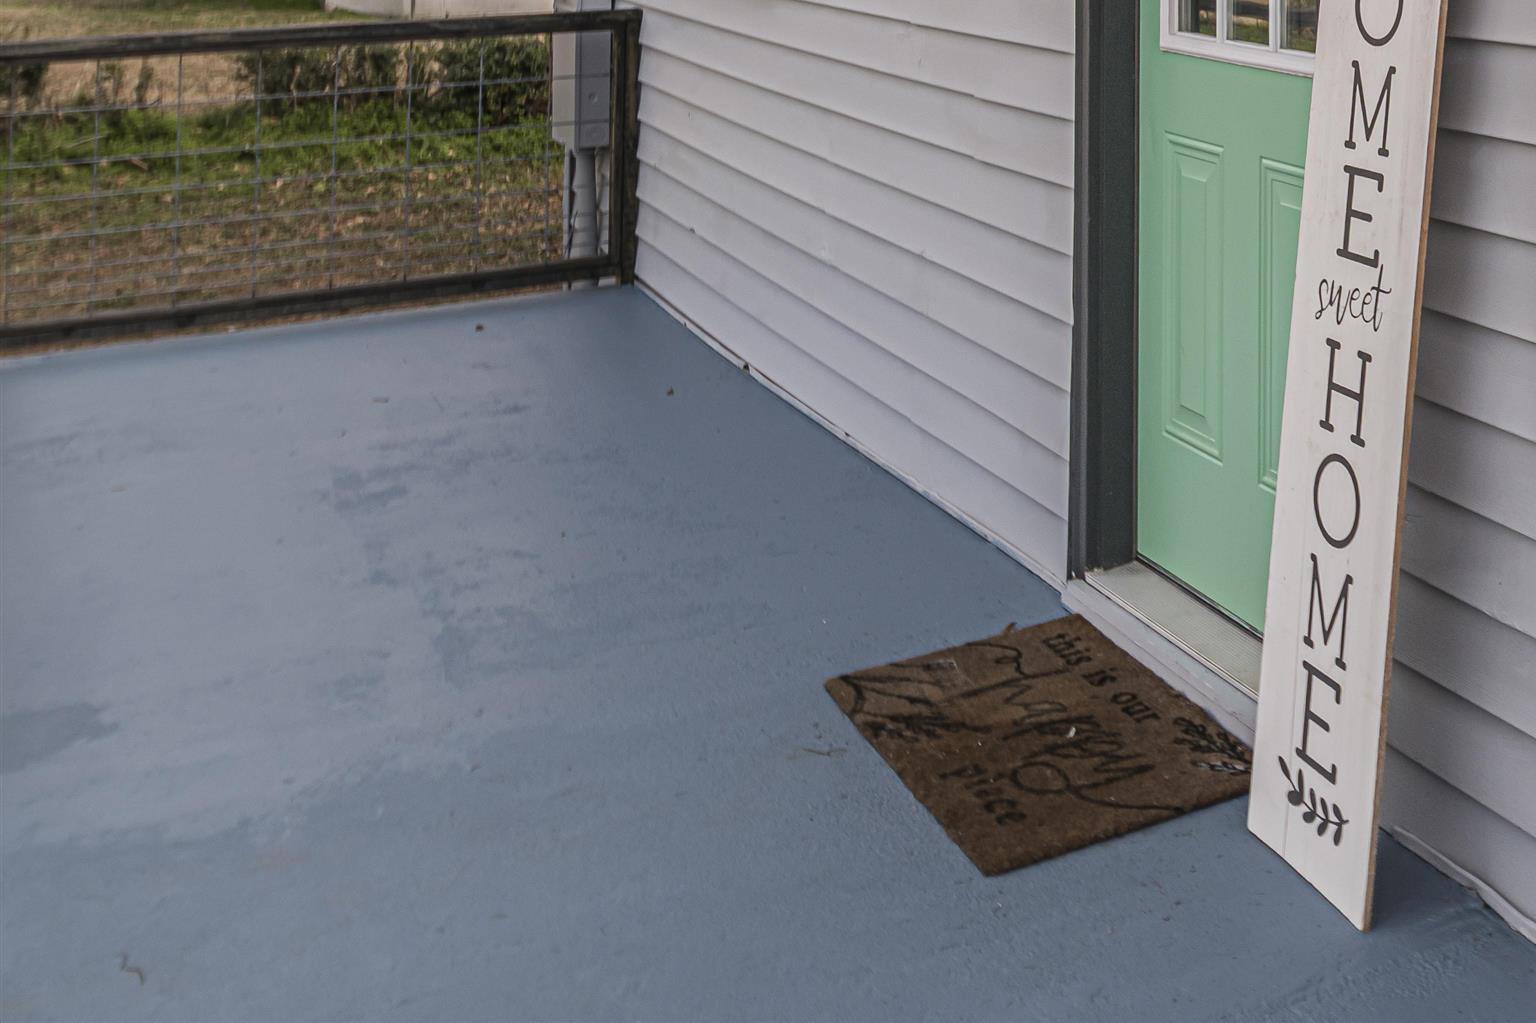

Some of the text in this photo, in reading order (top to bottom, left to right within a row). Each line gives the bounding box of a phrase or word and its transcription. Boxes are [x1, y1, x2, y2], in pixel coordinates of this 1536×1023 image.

[1313, 263, 1392, 333] sweet
[1295, 336, 1373, 786] HOME
[1041, 632, 1161, 724] this is our
